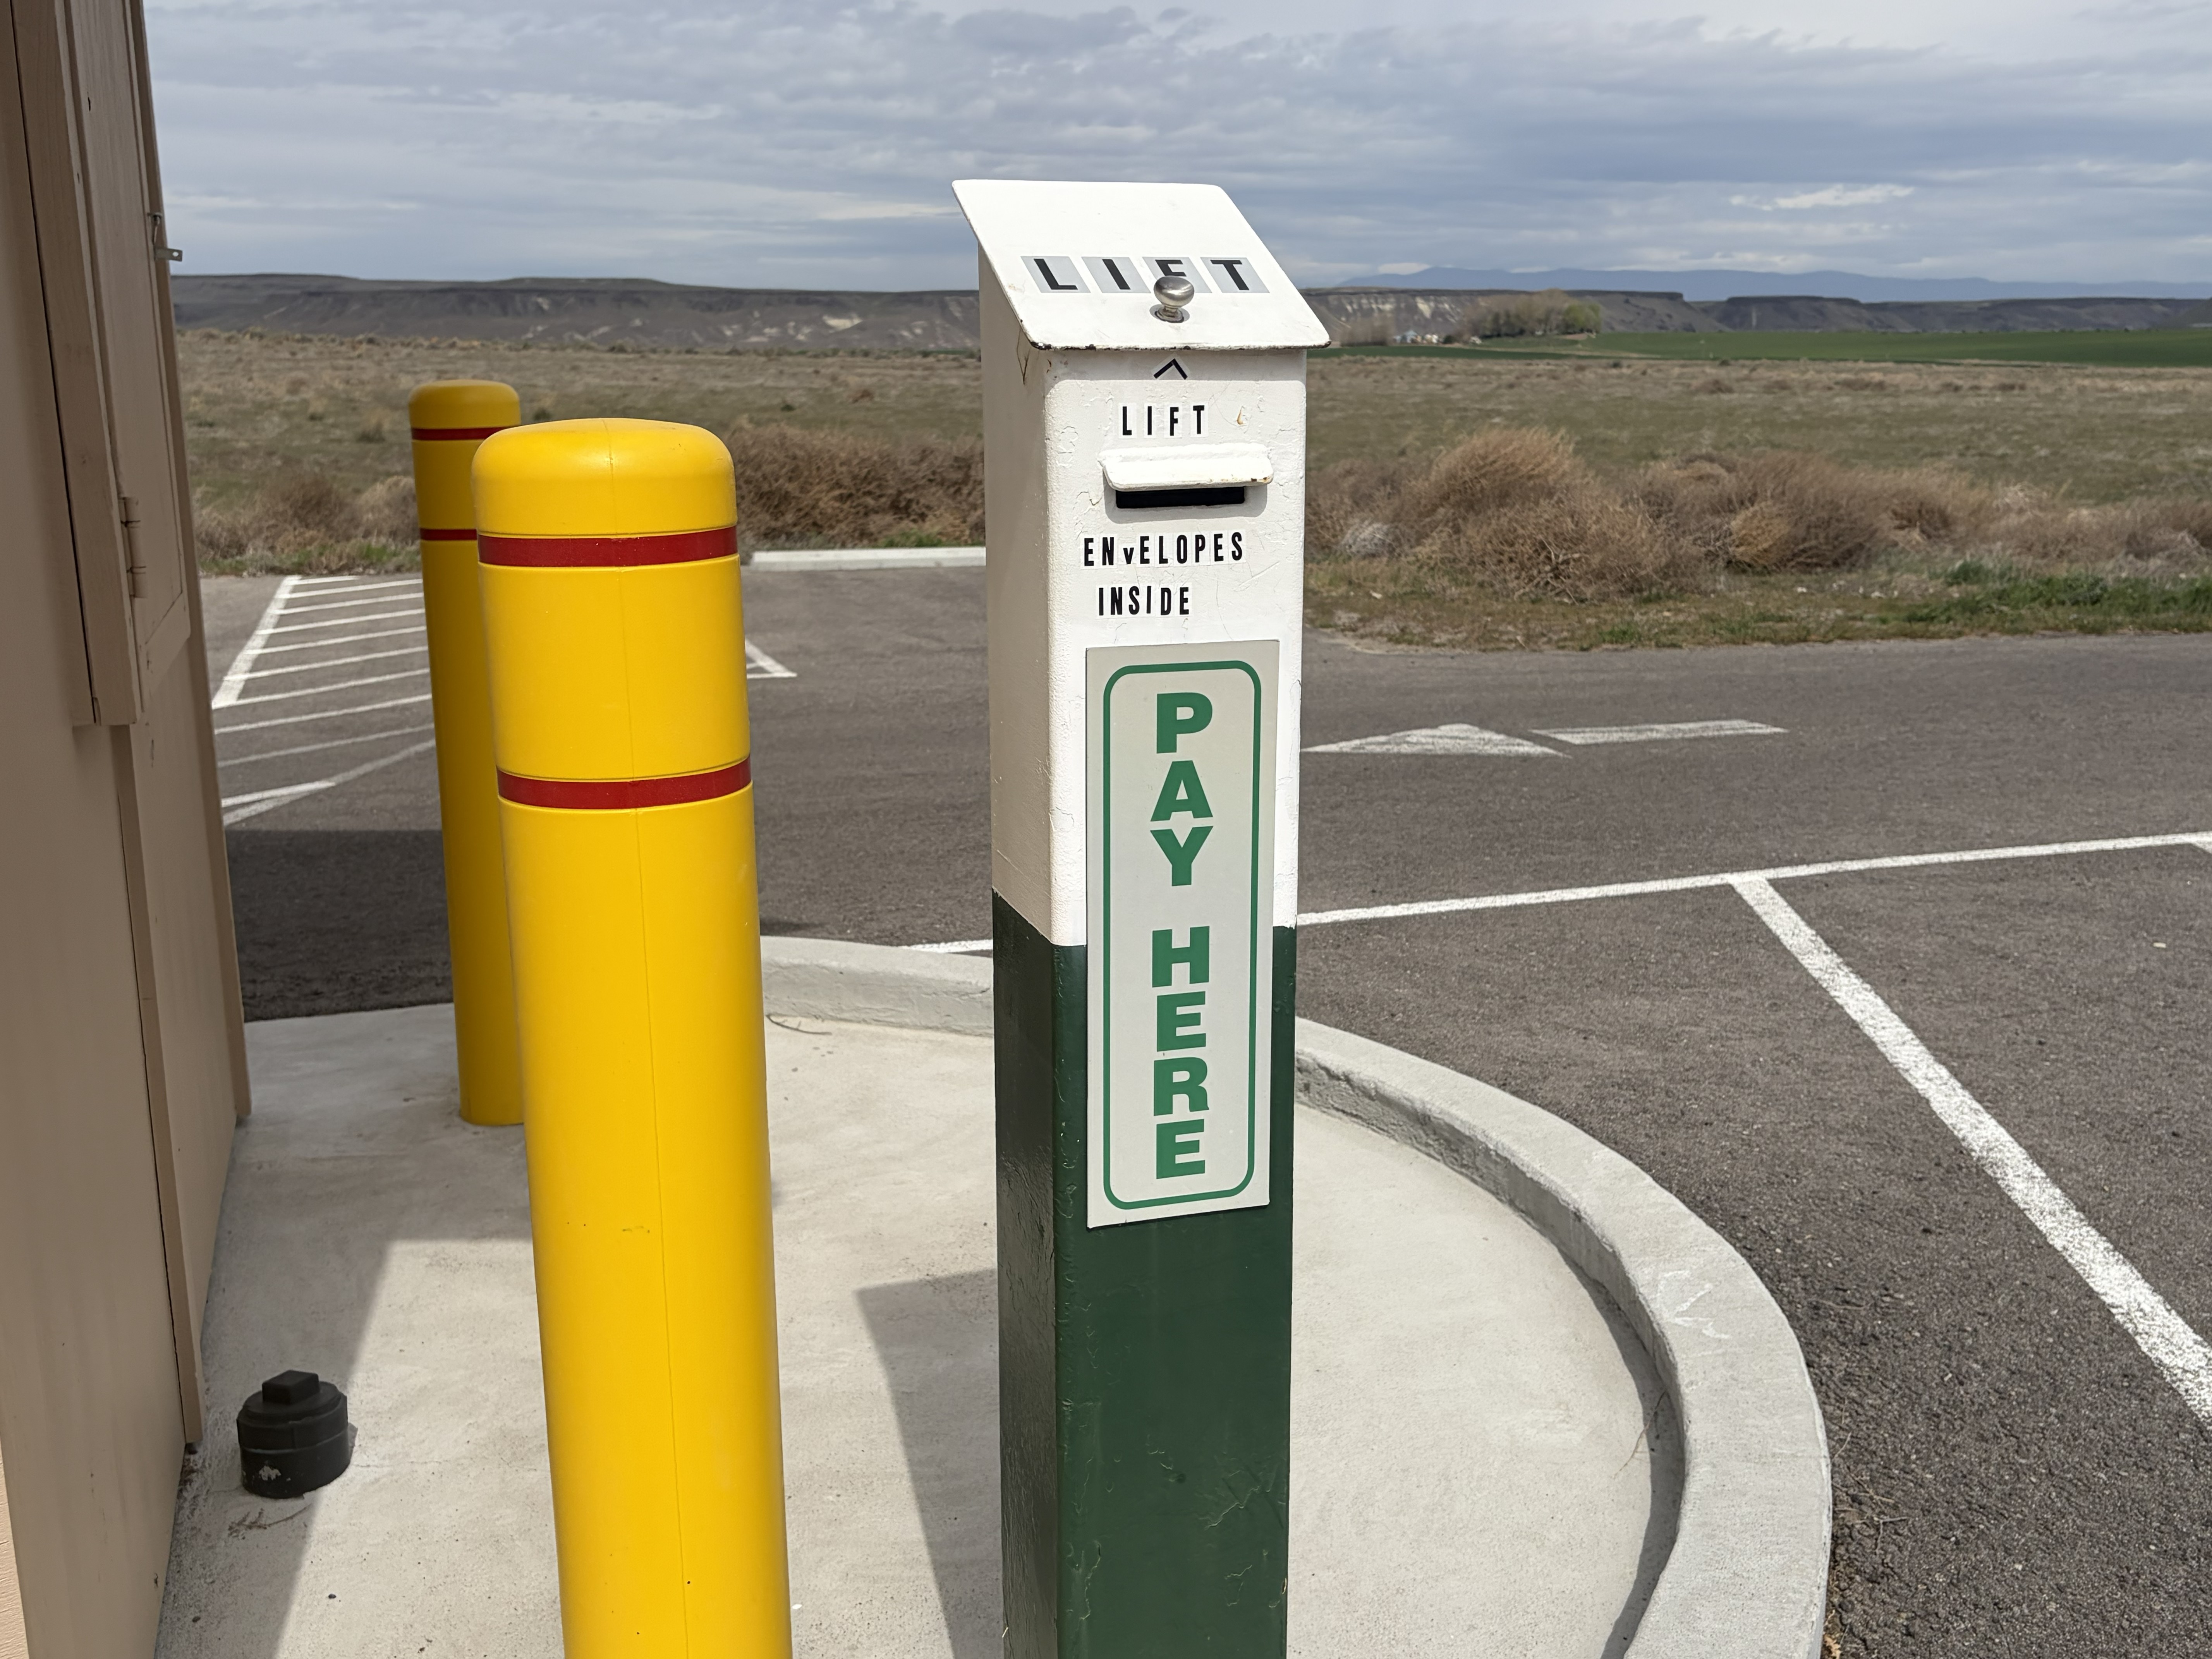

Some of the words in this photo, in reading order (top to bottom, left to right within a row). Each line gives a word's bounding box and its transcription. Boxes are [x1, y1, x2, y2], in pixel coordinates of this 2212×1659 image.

[1122, 405, 1205, 436] LIFT
[1099, 586, 1190, 616] INSIDE
[1152, 693, 1213, 886] PAY
[1152, 926, 1209, 1178] HERE
